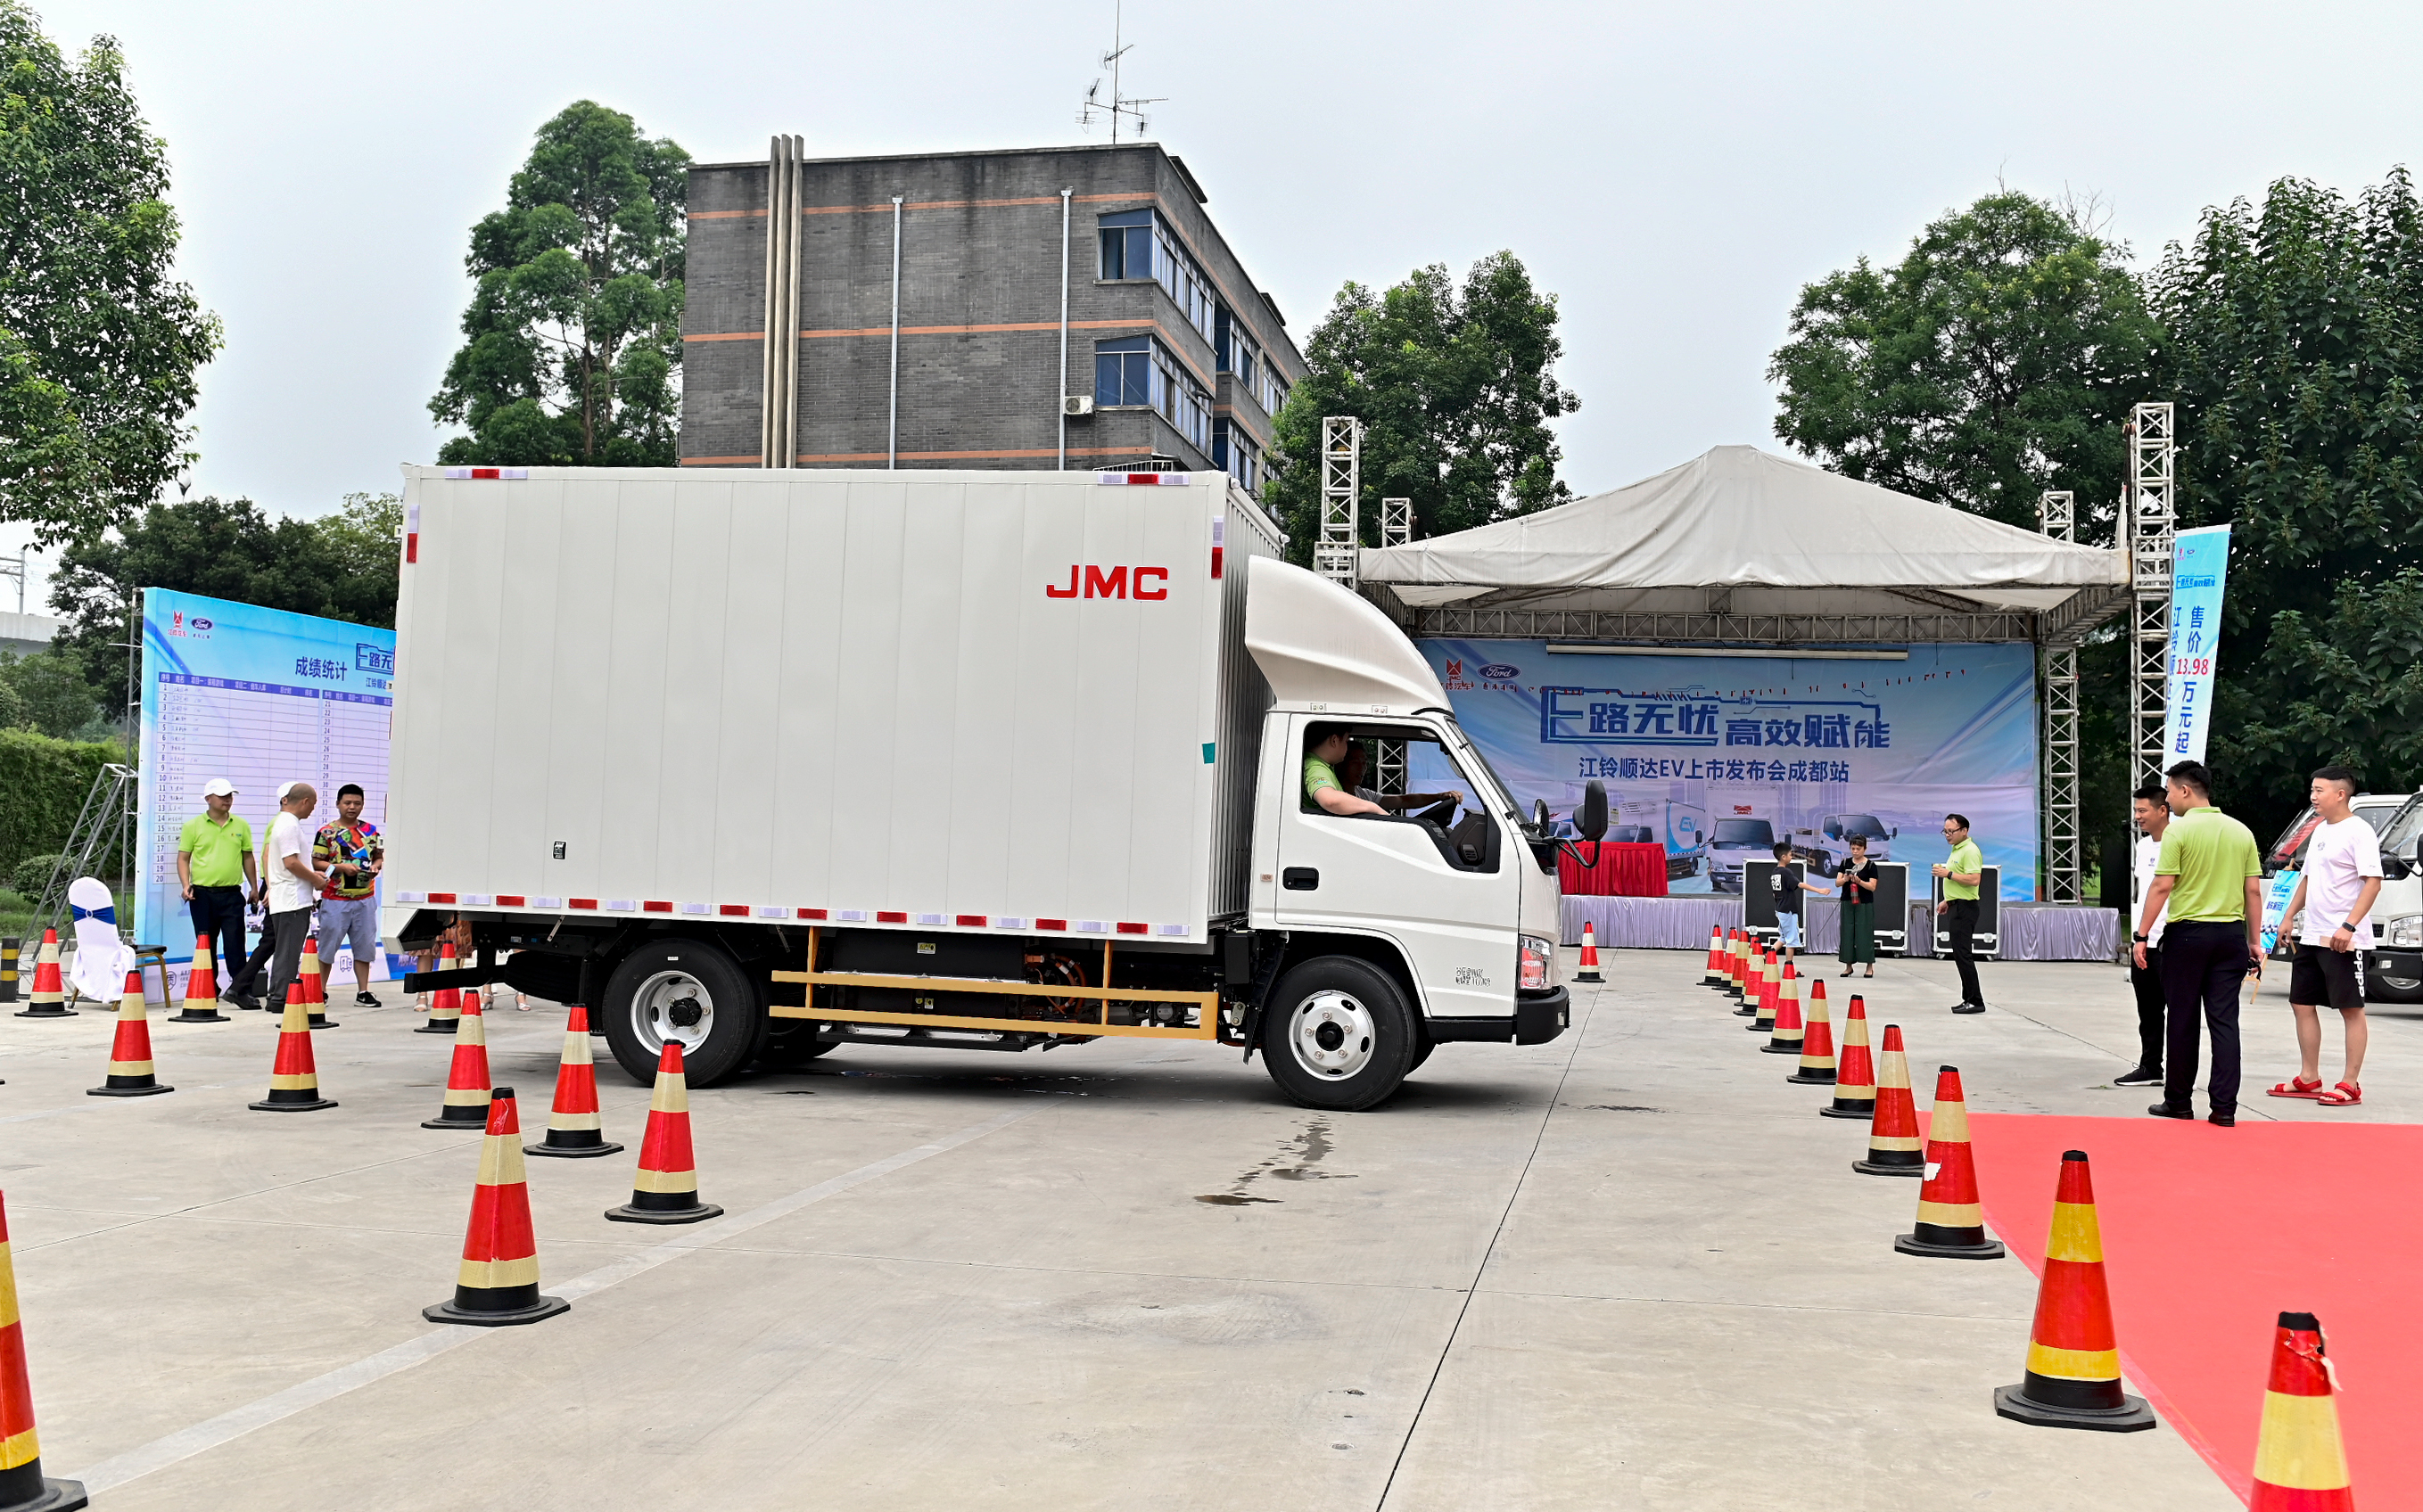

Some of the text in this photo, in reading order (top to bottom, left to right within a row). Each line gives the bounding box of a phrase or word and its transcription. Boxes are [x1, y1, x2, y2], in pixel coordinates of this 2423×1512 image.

[1046, 564, 1168, 600] JMC
[295, 656, 348, 681] 成绩统计
[2175, 605, 2209, 753] 售价13.98万元起
[1725, 713, 1891, 749] 高效赋能
[1578, 757, 1850, 783] 江铃顺达EV上市发布会成都站
[1679, 817, 1697, 832] EV
[2354, 949, 2364, 997] adida
